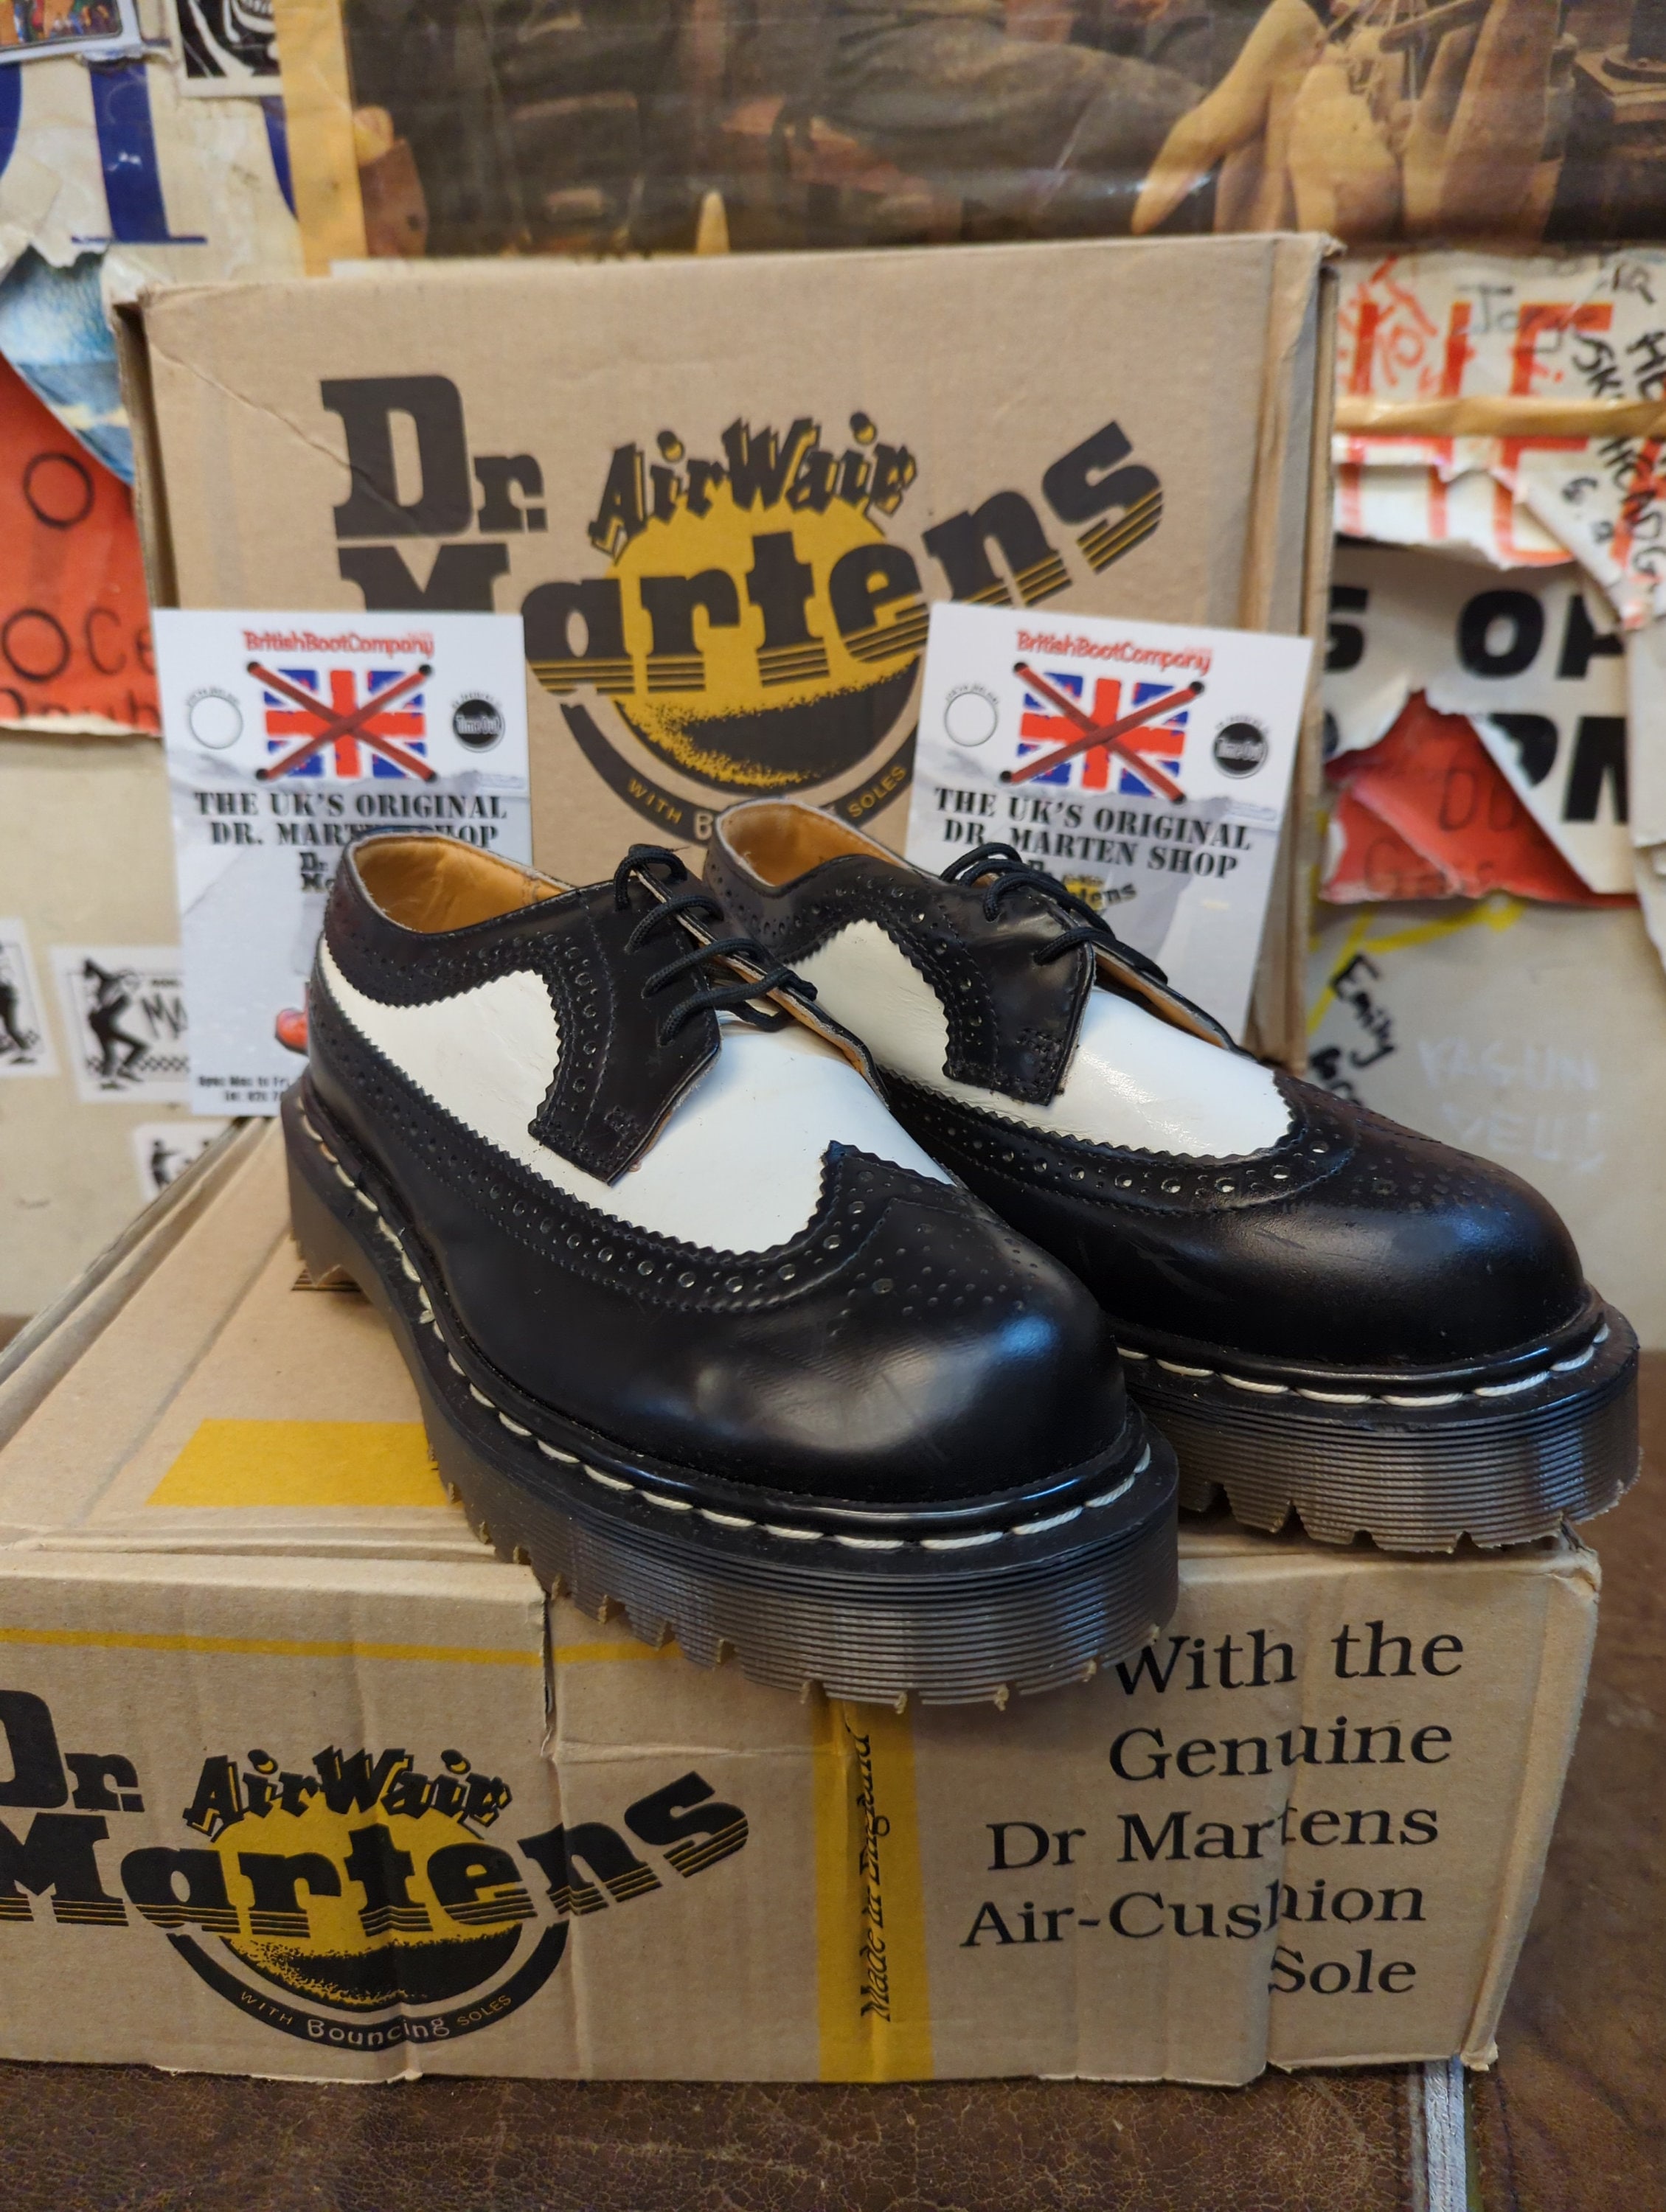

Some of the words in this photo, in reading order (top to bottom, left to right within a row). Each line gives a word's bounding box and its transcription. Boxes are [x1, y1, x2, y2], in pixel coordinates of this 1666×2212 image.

[320, 375, 548, 540] Dr.
[588, 411, 917, 565] AirWair
[195, 791, 258, 815] THE
[271, 793, 344, 818] UK'S
[355, 795, 507, 820] ORIGINAL
[628, 778, 683, 825] WITH
[846, 764, 907, 819] SOLES
[934, 787, 996, 817] THE
[1009, 796, 1083, 829] UK'S
[1093, 805, 1252, 852] ORIGINAL
[211, 821, 263, 845] DR.
[1010, 827, 1139, 867] MARTEN
[1147, 844, 1239, 879] SHOP
[1114, 1628, 1297, 1695] With
[1331, 1620, 1464, 1680] the
[1108, 1716, 1453, 1781] Genuine
[182, 1745, 513, 1843] AirWair
[0, 1771, 749, 1938] Martens
[986, 1821, 1086, 1871] Dr
[1117, 1798, 1440, 1863] Martens
[959, 1879, 1426, 1947] Air-Cushion
[1268, 1945, 1417, 1995] Sole
[240, 1991, 293, 2026] WITH
[307, 2017, 451, 2047] Bouncing
[456, 1994, 513, 2027] SOLES
